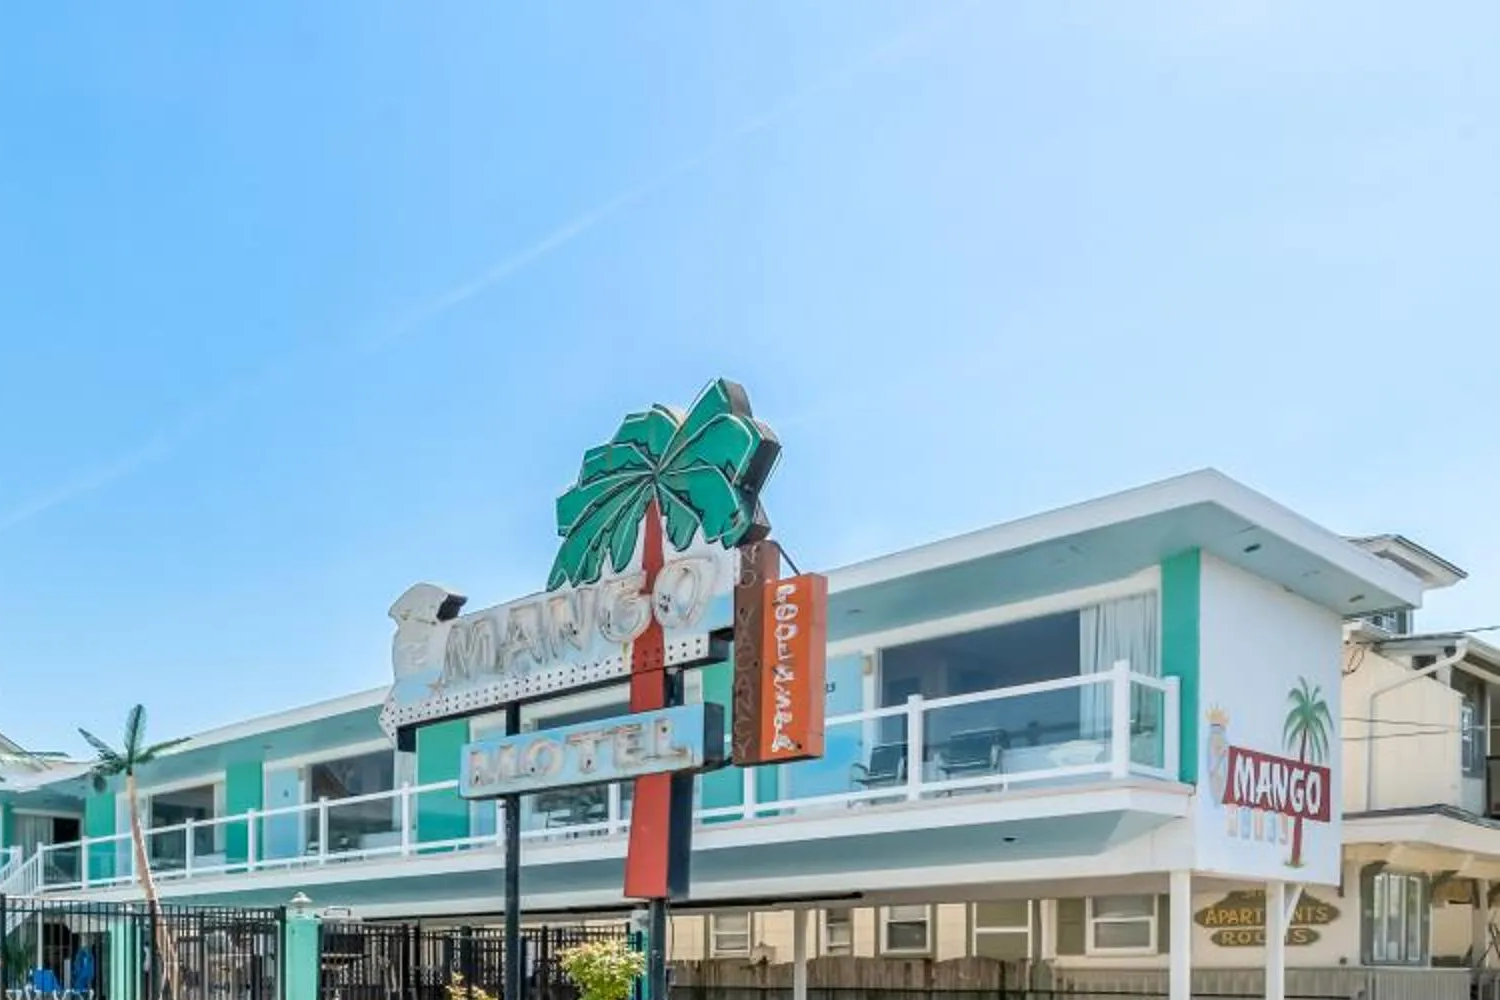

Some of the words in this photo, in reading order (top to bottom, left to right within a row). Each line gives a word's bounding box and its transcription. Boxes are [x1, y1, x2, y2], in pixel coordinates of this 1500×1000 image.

[442, 556, 717, 685] MANGO
[774, 584, 799, 661] POOL
[469, 718, 694, 788] MOTEL
[1234, 752, 1321, 815] MANGO
[1204, 905, 1329, 925] APARTNTS
